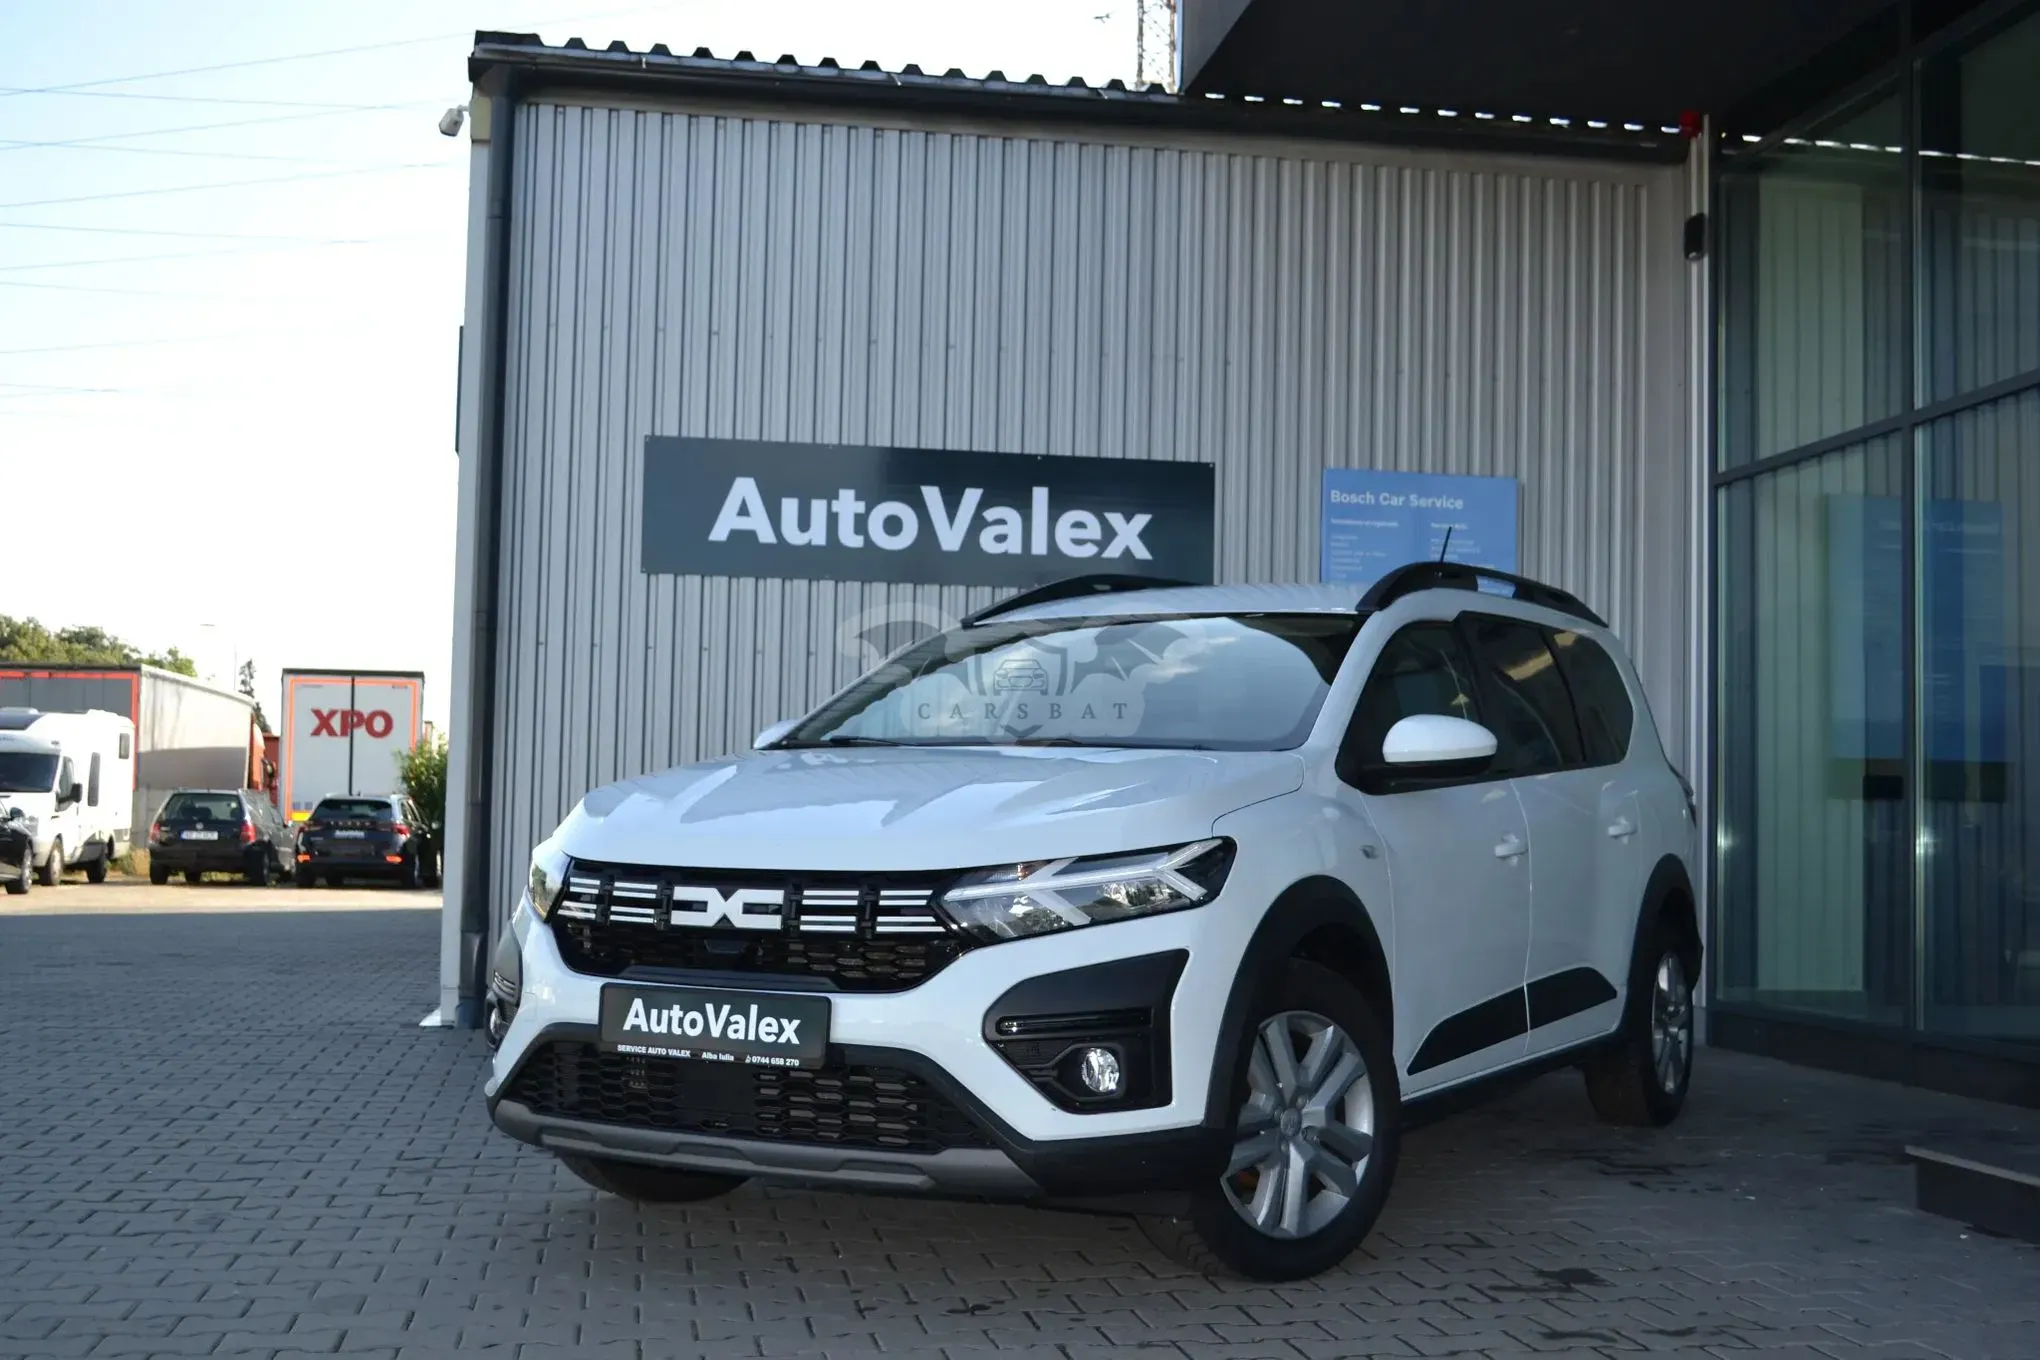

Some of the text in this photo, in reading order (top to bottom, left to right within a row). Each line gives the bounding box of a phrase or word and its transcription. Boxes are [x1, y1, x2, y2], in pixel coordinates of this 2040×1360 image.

[1330, 489, 1464, 510] Bosch Car Service
[708, 477, 1153, 560] AutoValex
[310, 707, 394, 738] XPO
[623, 998, 801, 1045] AutoValex
[617, 1044, 647, 1054] SERVICE
[647, 1045, 667, 1056] AUTO
[667, 1047, 691, 1058] VALEX
[701, 1051, 718, 1061] Alba
[751, 1056, 770, 1064] 0744
[771, 1057, 784, 1065] 658
[785, 1058, 800, 1067] 270
